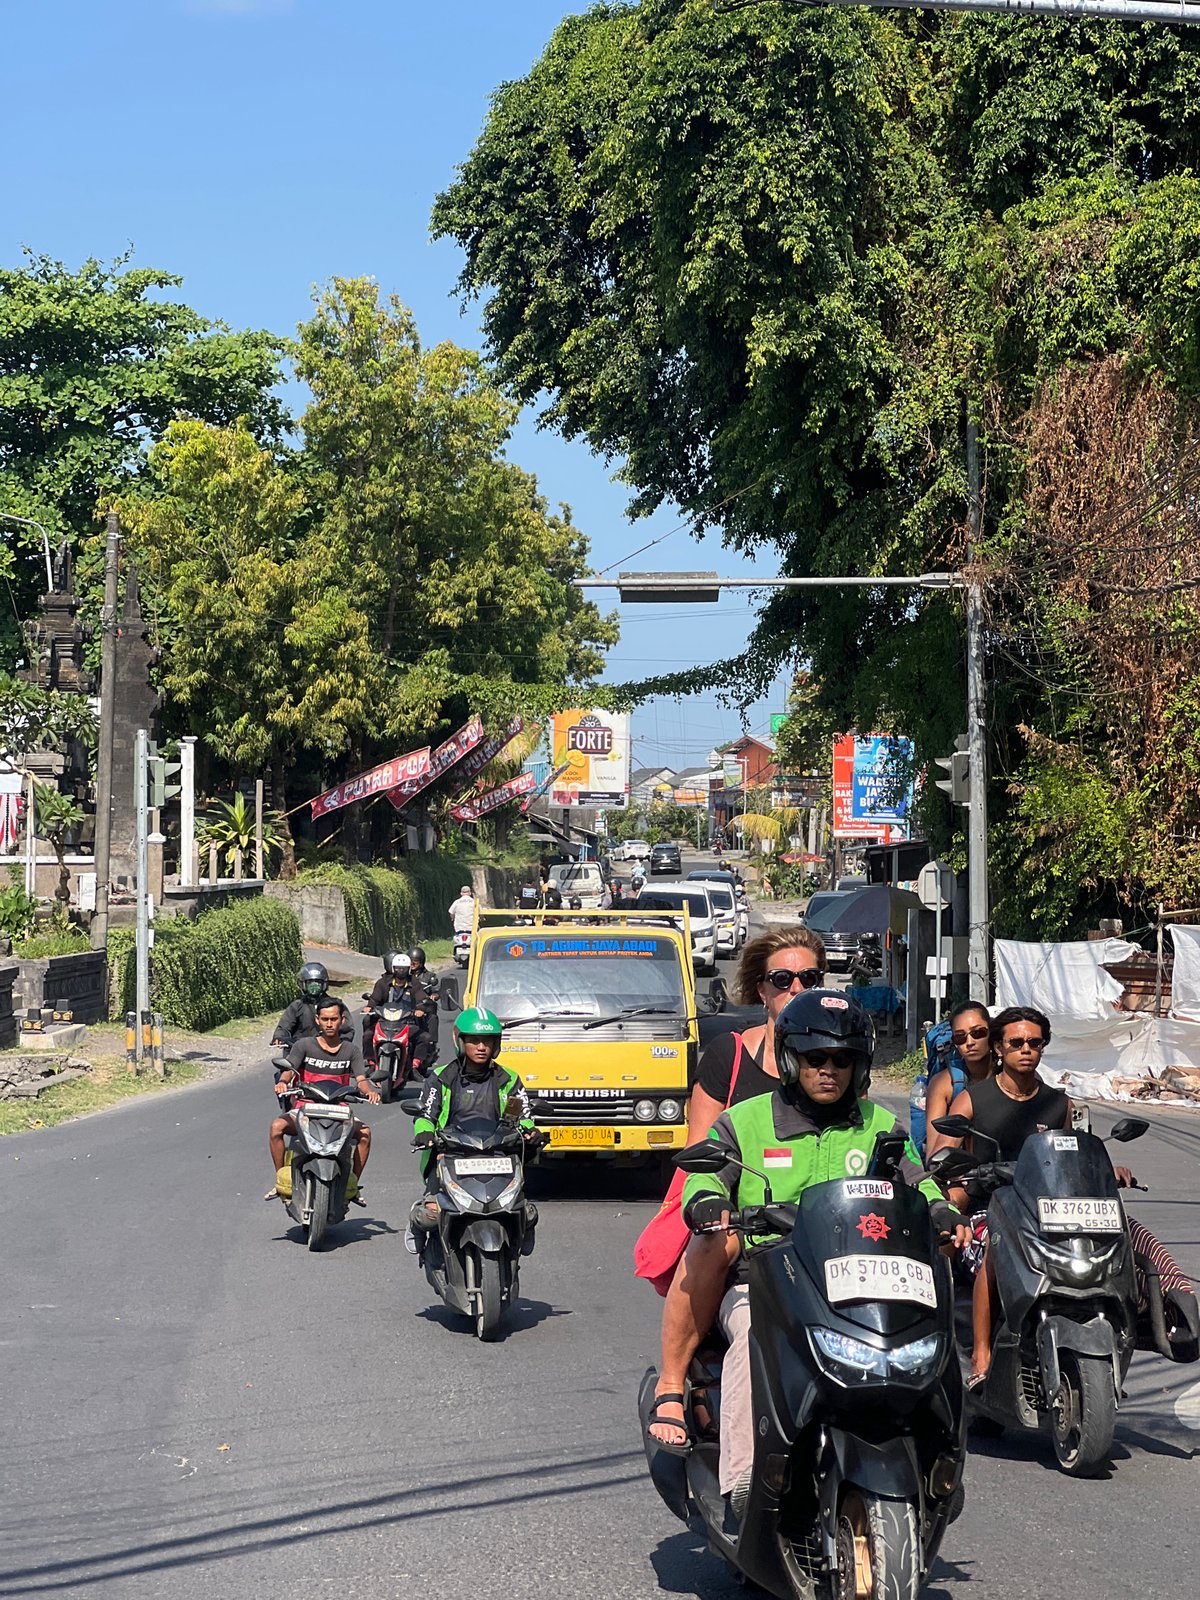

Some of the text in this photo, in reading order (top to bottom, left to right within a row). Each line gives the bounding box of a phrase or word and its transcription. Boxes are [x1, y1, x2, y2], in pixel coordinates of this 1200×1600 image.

[569, 730, 612, 750] FORTE
[344, 752, 427, 801] PUTRA POP
[511, 774, 533, 795] POP
[836, 806, 843, 814] &
[552, 940, 591, 952] AGUNG
[592, 940, 620, 952] JAYA
[622, 940, 657, 952] ABADI
[475, 1023, 494, 1031] Grab
[538, 1089, 625, 1098] MITSUBISHI
[552, 1128, 613, 1140] DK 8510 UA
[1043, 1202, 1117, 1215] DK 3762 UBX
[830, 1259, 932, 1285] DK 5708 GBJ
